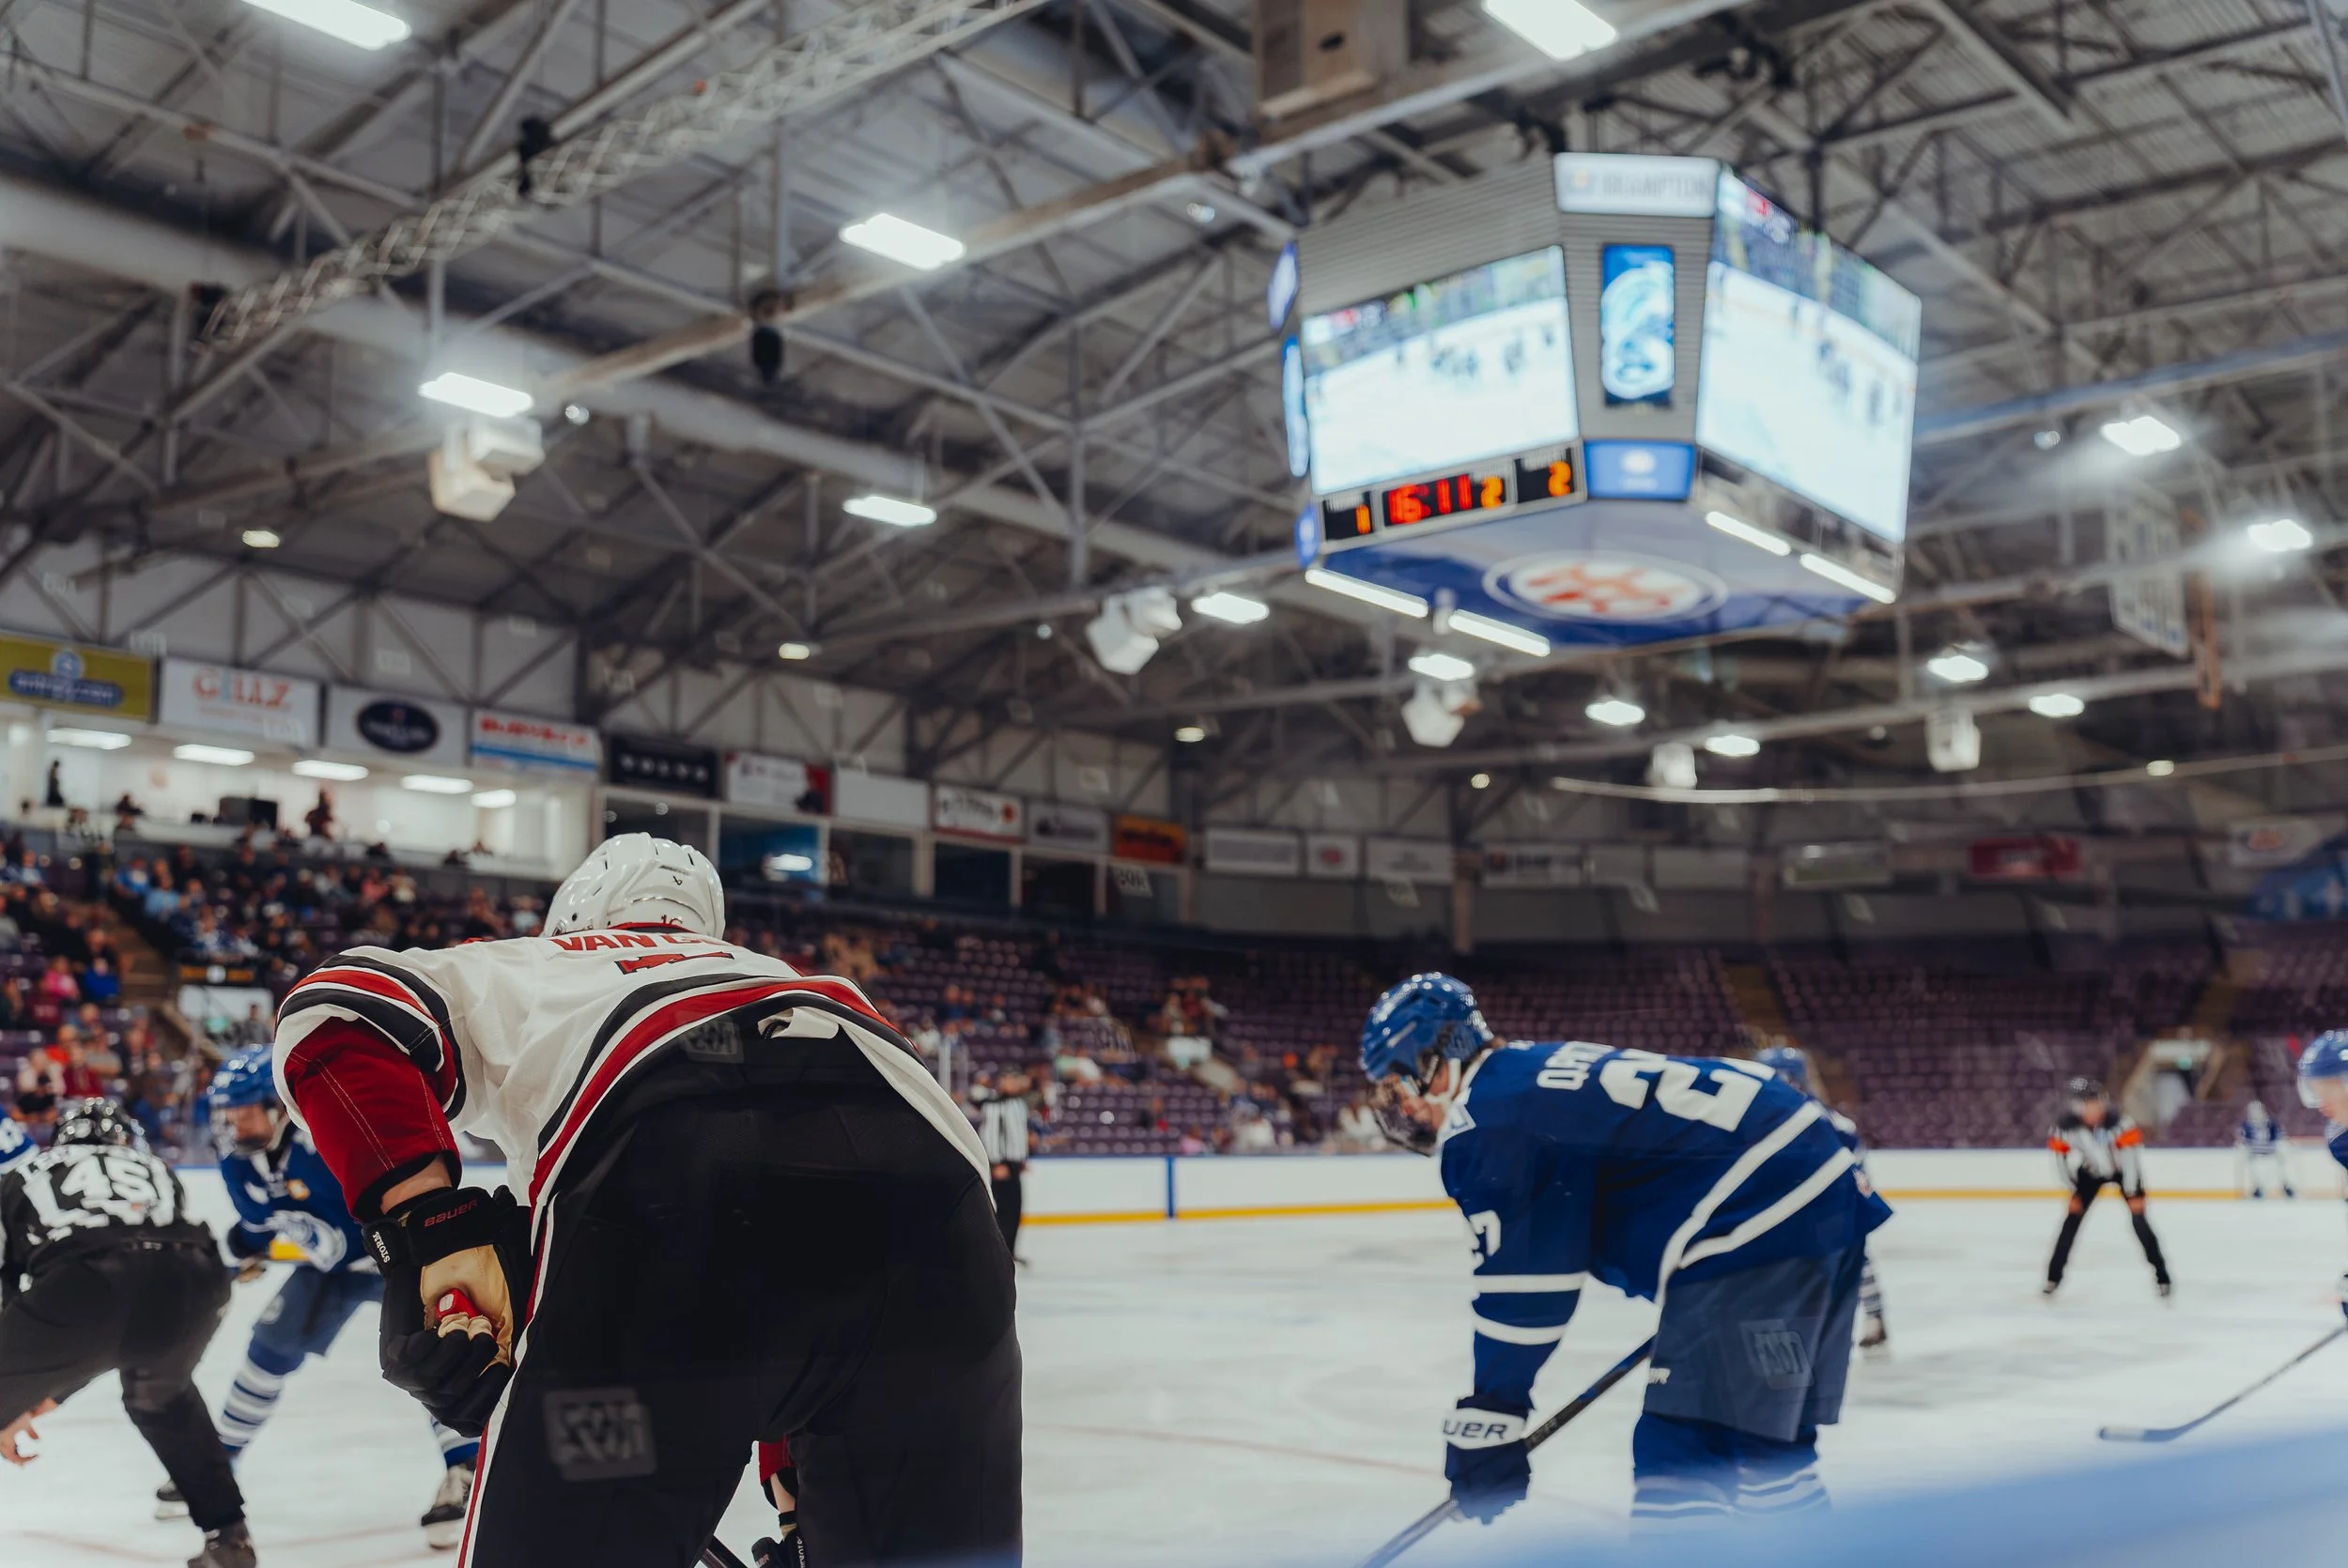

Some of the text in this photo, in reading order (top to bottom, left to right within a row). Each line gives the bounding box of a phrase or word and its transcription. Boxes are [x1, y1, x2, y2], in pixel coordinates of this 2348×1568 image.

[1480, 474, 1504, 511] 2
[1549, 460, 1572, 497] 2
[549, 934, 657, 951] VAN
[59, 1154, 160, 1206] 45
[372, 1231, 391, 1264] STORM
